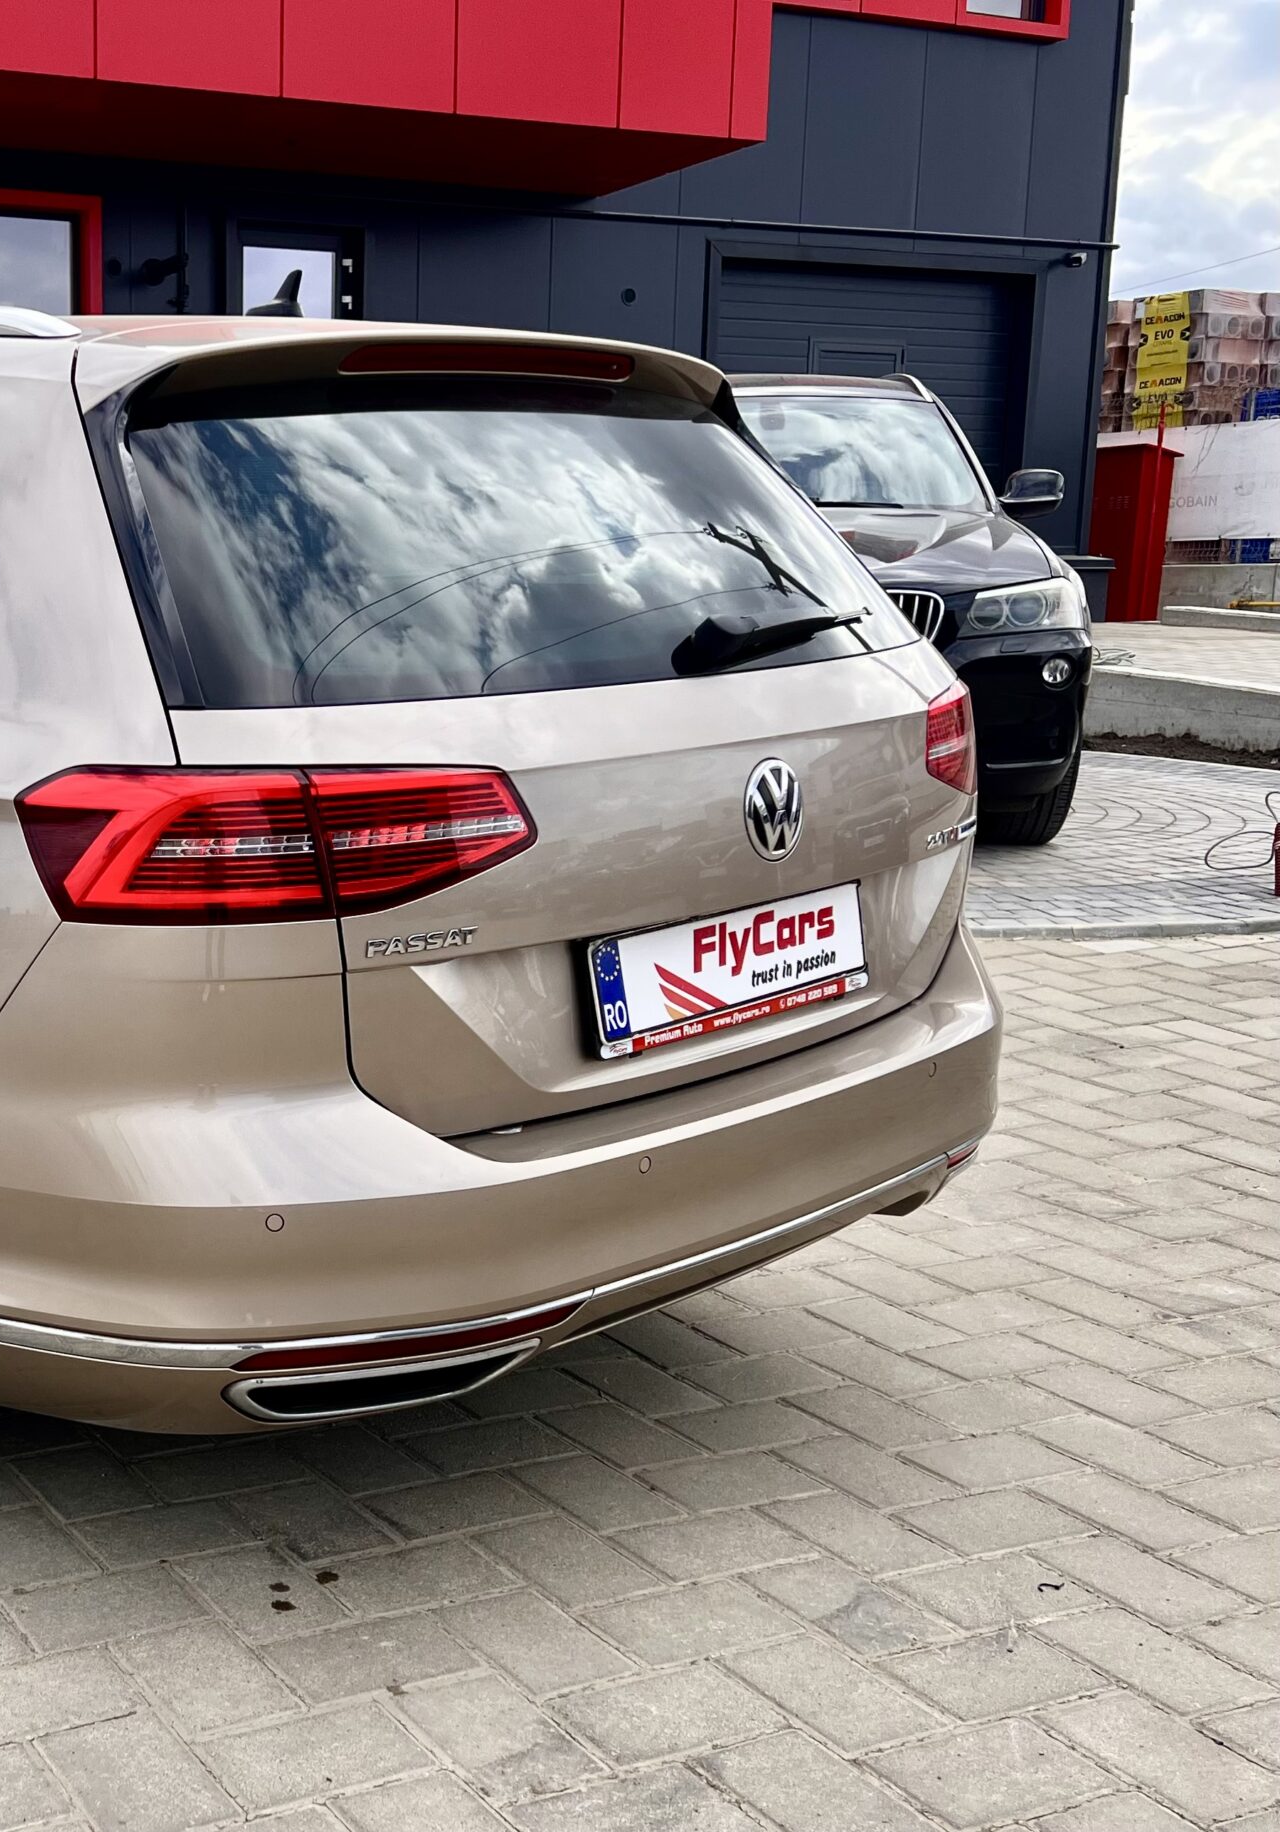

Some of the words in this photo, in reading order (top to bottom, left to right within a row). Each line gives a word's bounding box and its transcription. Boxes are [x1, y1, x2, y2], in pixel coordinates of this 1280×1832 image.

[1153, 328, 1175, 341] EVO
[366, 926, 478, 958] PASSAT
[693, 905, 835, 977] FlyCars
[751, 963, 779, 988] trust
[782, 960, 793, 978] in
[796, 949, 836, 979] passion
[604, 1000, 627, 1032] RO
[645, 1028, 681, 1047] Premium
[683, 1021, 703, 1036] Auto
